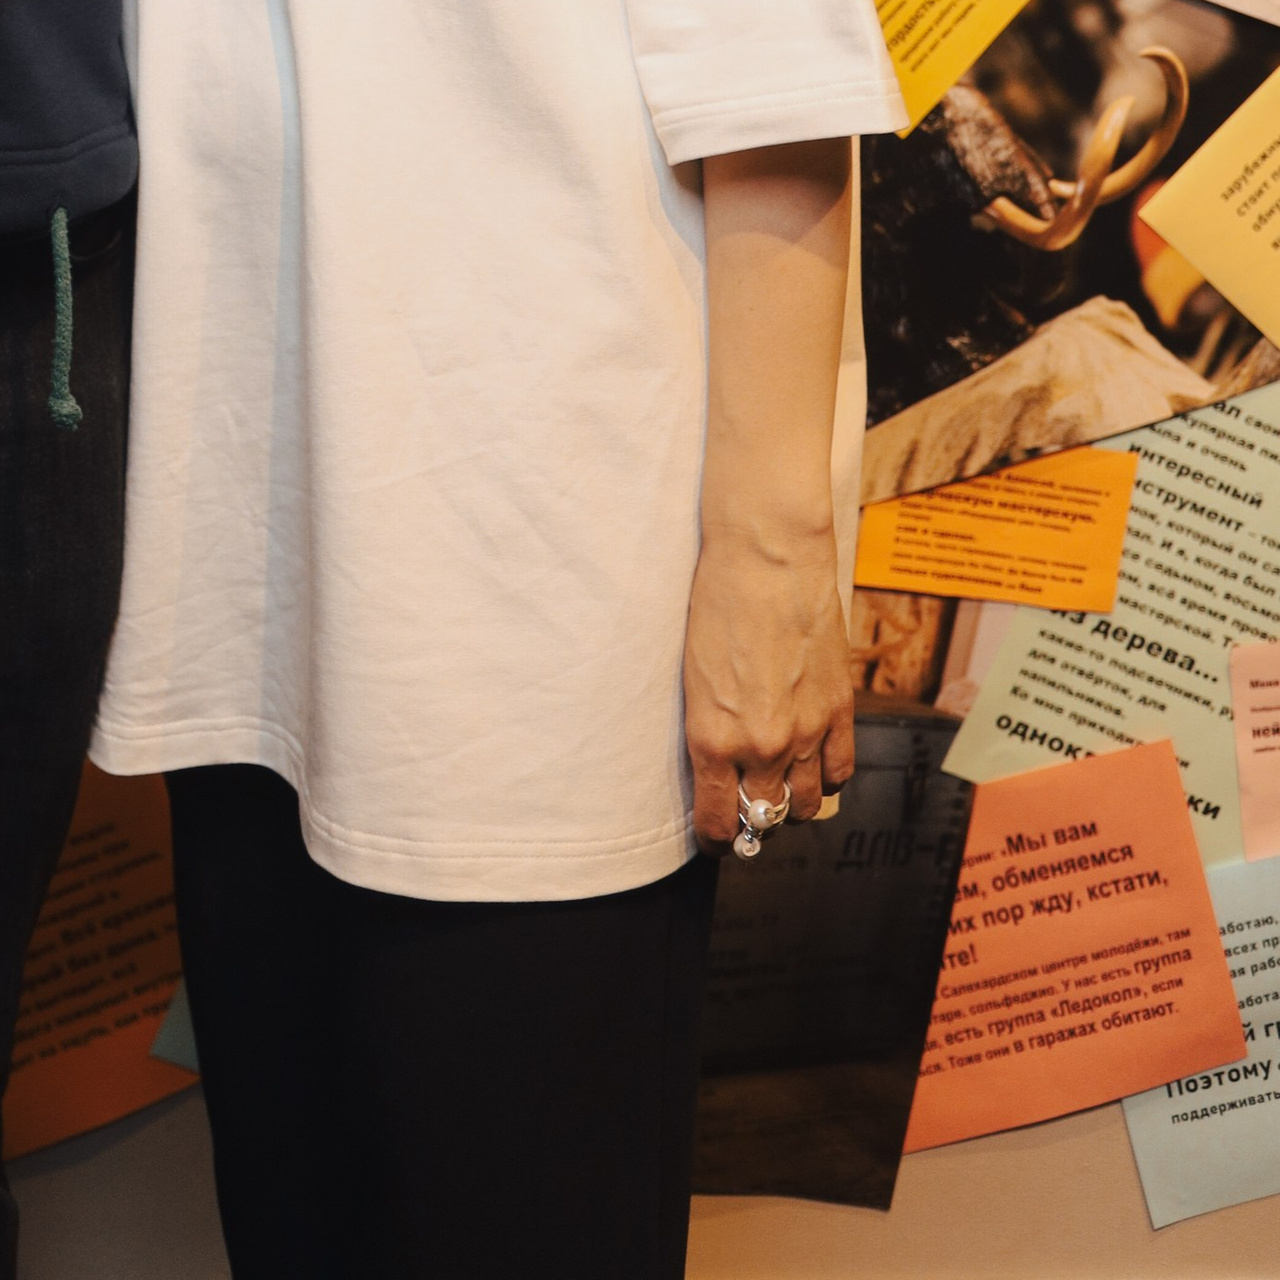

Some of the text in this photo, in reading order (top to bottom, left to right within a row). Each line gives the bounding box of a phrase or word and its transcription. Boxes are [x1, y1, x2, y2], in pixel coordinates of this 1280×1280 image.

[1052, 821, 1098, 845] вам
[991, 844, 1134, 892] обменяемся
[981, 869, 1168, 928] пор жду, кстати,
